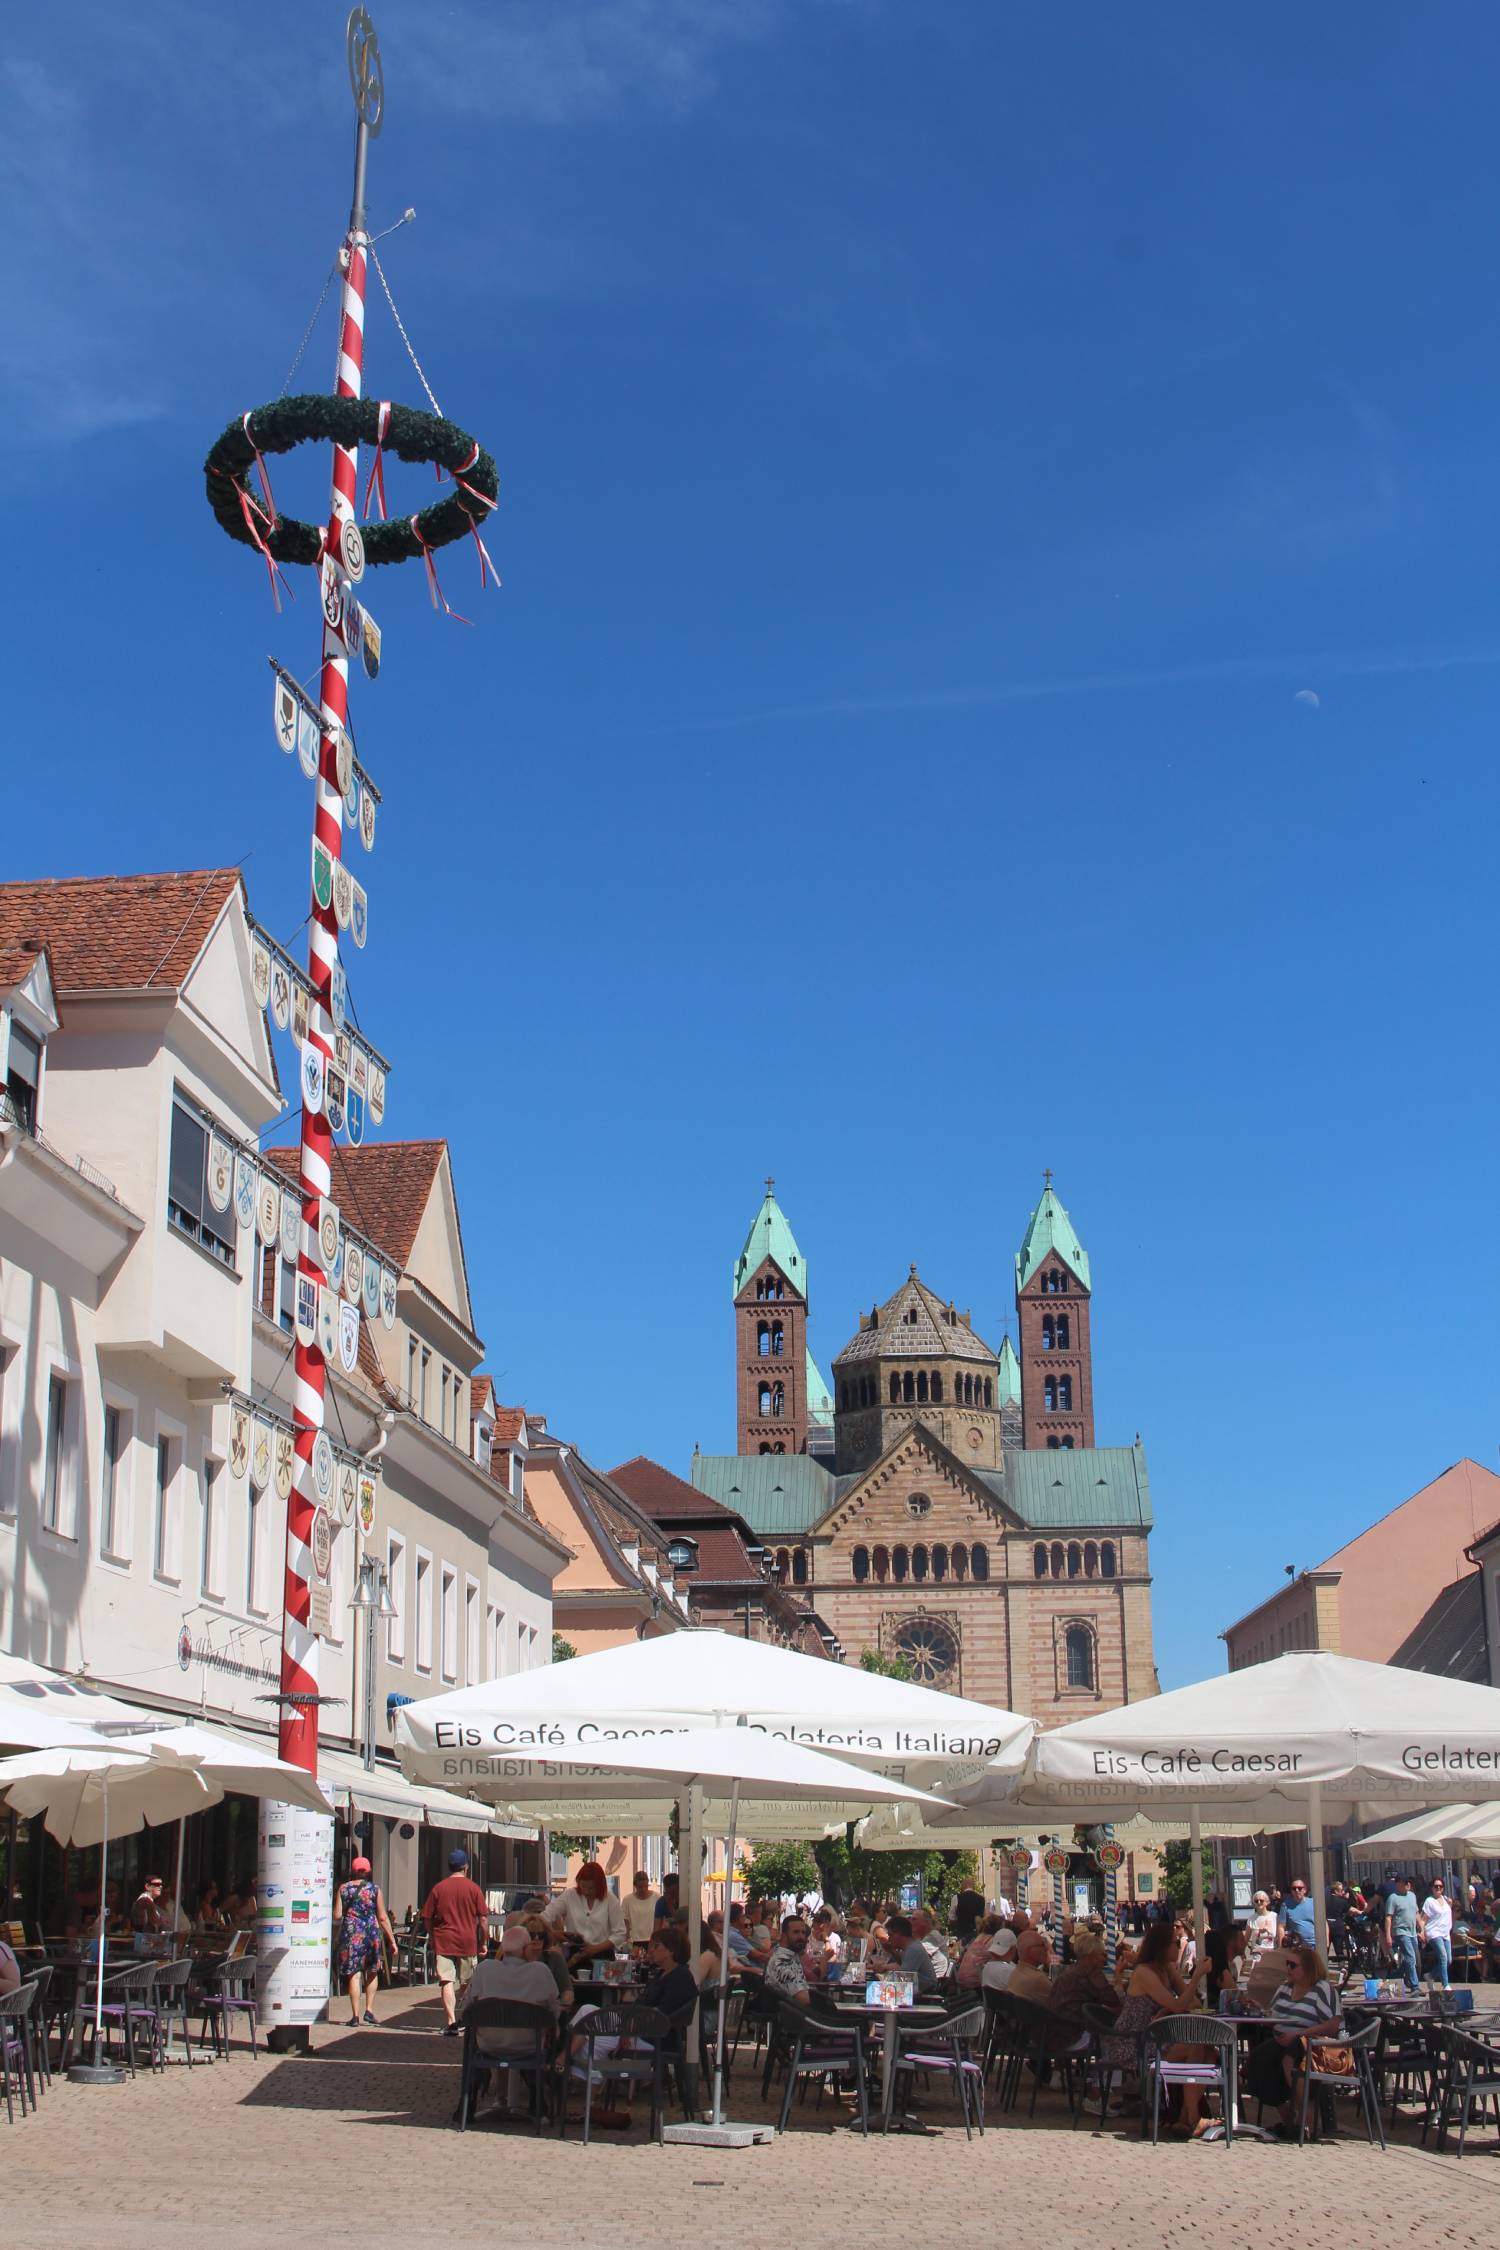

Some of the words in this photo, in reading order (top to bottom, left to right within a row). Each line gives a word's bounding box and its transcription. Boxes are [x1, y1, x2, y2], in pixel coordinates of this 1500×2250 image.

[435, 1721, 481, 1749] Eis
[493, 1723, 565, 1745] Café
[896, 1730, 1001, 1755] Italiana
[1093, 1749, 1202, 1775] Eis-Cafè
[1211, 1749, 1302, 1773] Caesar
